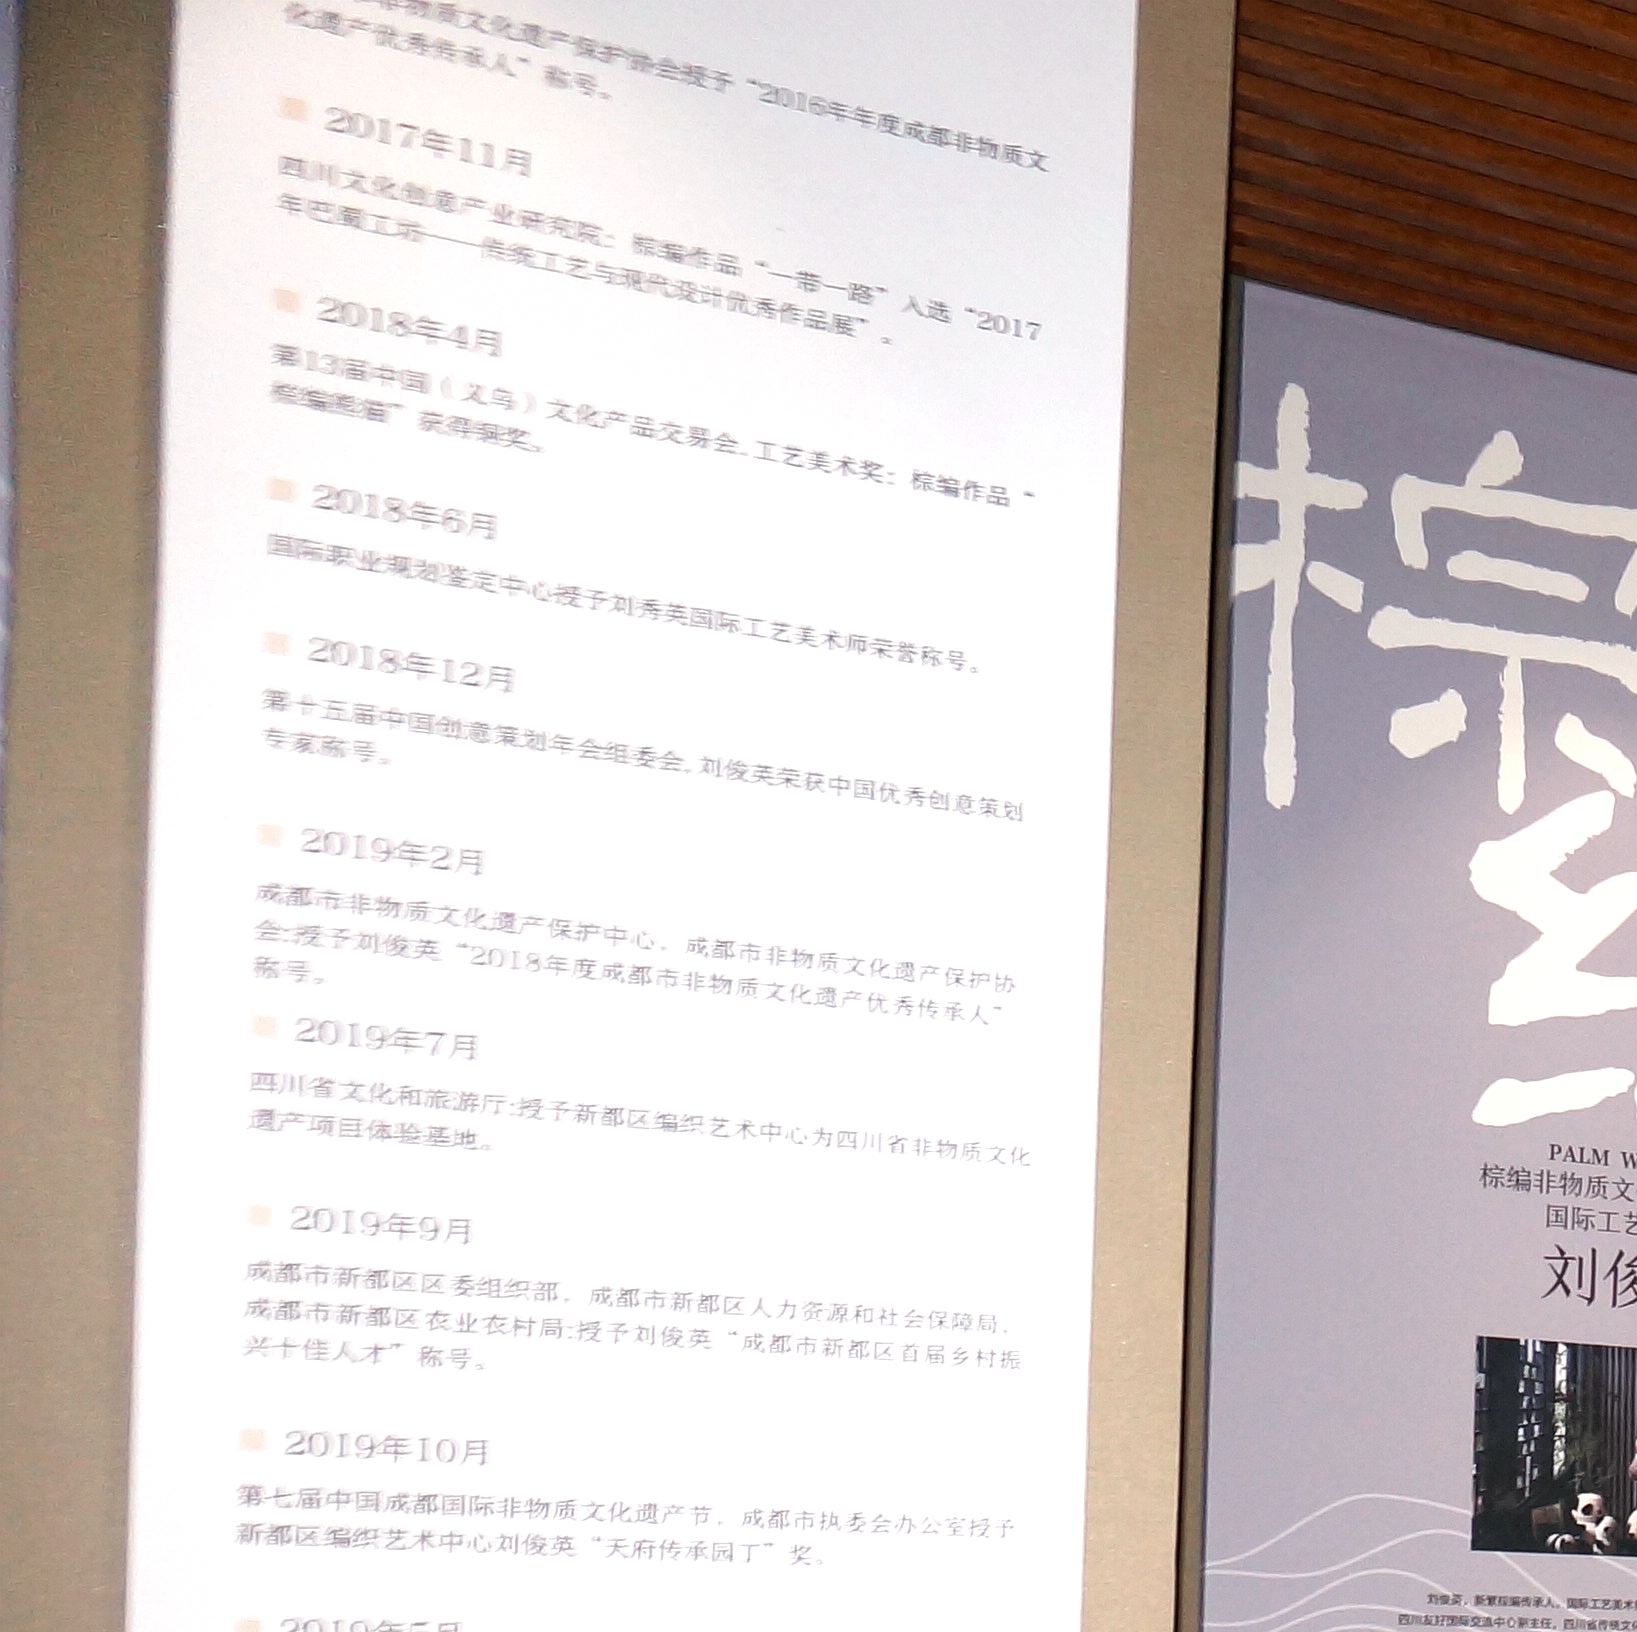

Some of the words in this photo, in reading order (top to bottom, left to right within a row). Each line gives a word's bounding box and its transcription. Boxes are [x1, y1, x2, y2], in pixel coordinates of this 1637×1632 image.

[324, 106, 531, 177] 2017年11月
[316, 296, 502, 357] 2018年4月
[312, 484, 497, 540] 2018年6月
[307, 636, 514, 692] 2018年12月
[301, 827, 483, 875] 2019年2月
[294, 1017, 478, 1060] 2019年7月
[1549, 1143, 1610, 1167] PALM
[290, 1205, 471, 1244] 2019年9月
[284, 1430, 488, 1465] 2019年10月
